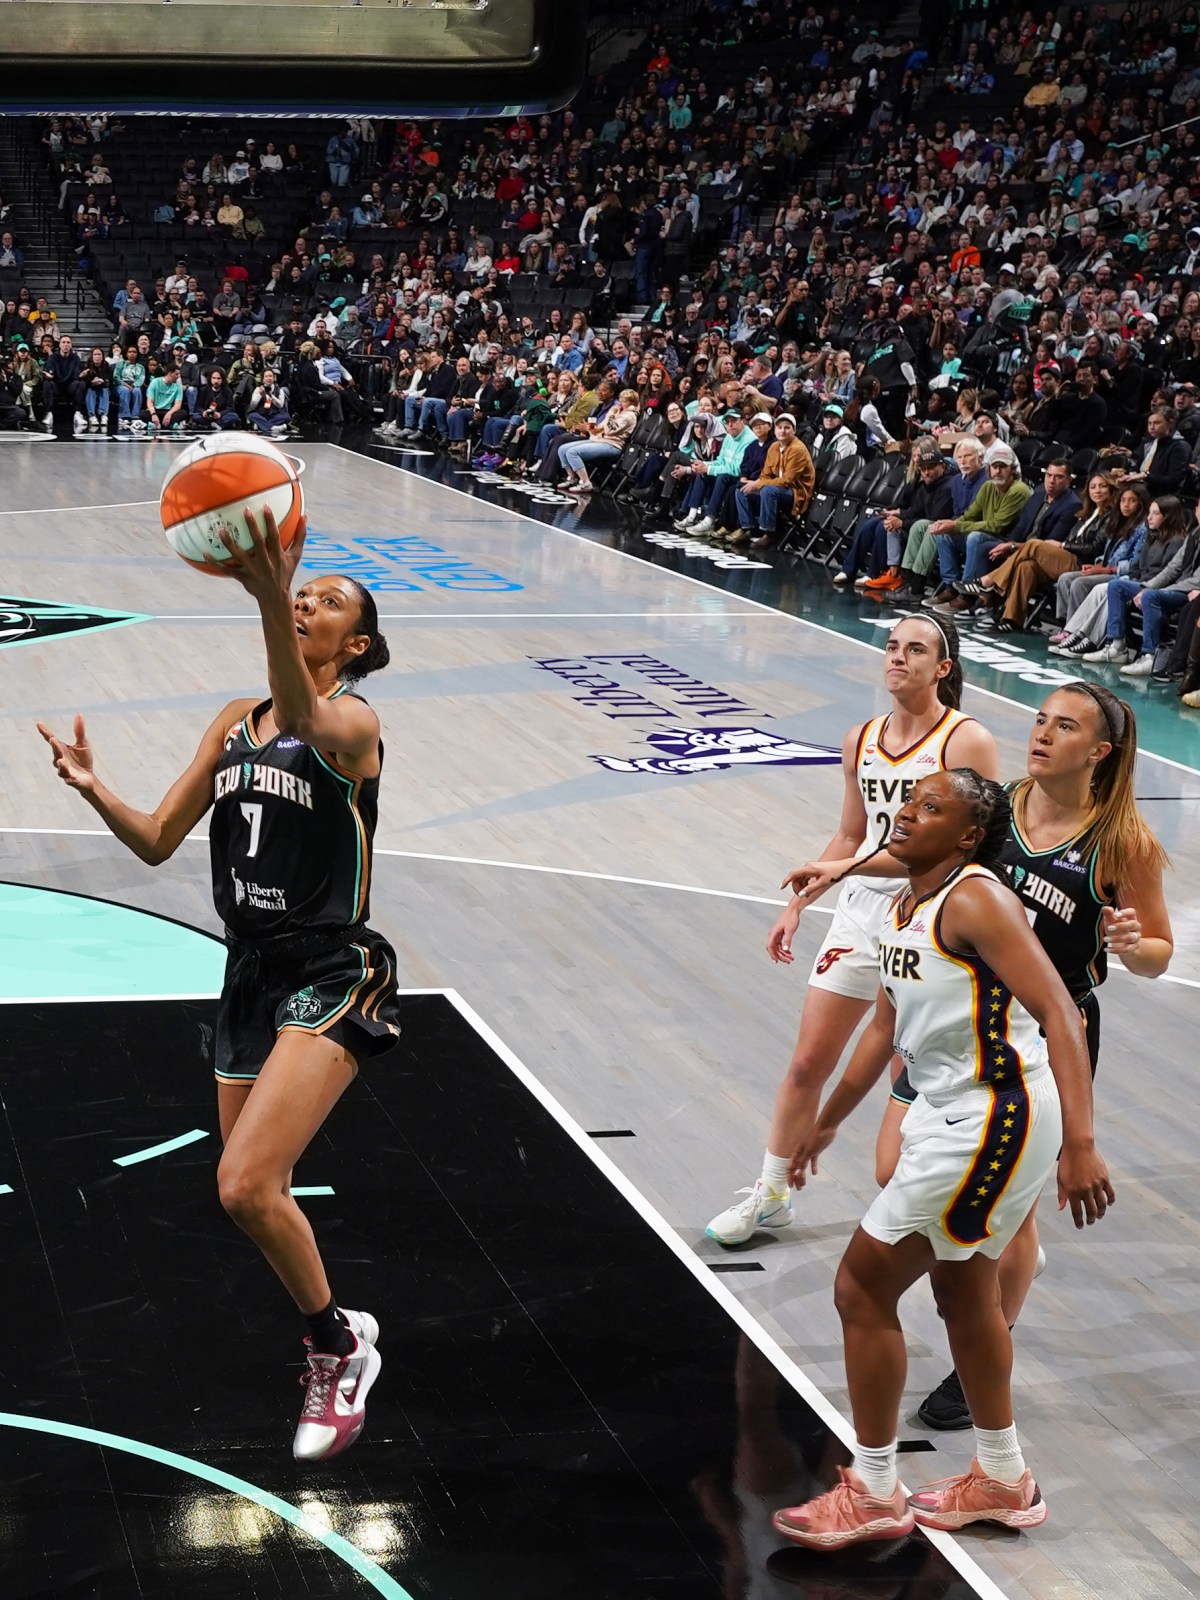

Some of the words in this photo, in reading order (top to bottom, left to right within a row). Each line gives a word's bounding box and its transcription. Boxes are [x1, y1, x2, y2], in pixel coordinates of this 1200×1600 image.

[352, 536, 525, 592] CENTER
[525, 654, 682, 720] Liberty
[583, 653, 777, 720] Mutual
[215, 764, 242, 801] EW
[253, 763, 314, 811] YORK
[862, 778, 920, 803] FEVE
[239, 802, 263, 858] 7
[876, 811, 891, 848] 2
[246, 881, 285, 899] Liberty
[1053, 859, 1087, 874] BARCLAYS
[249, 893, 287, 911] Mutual
[1022, 872, 1077, 925] YORK
